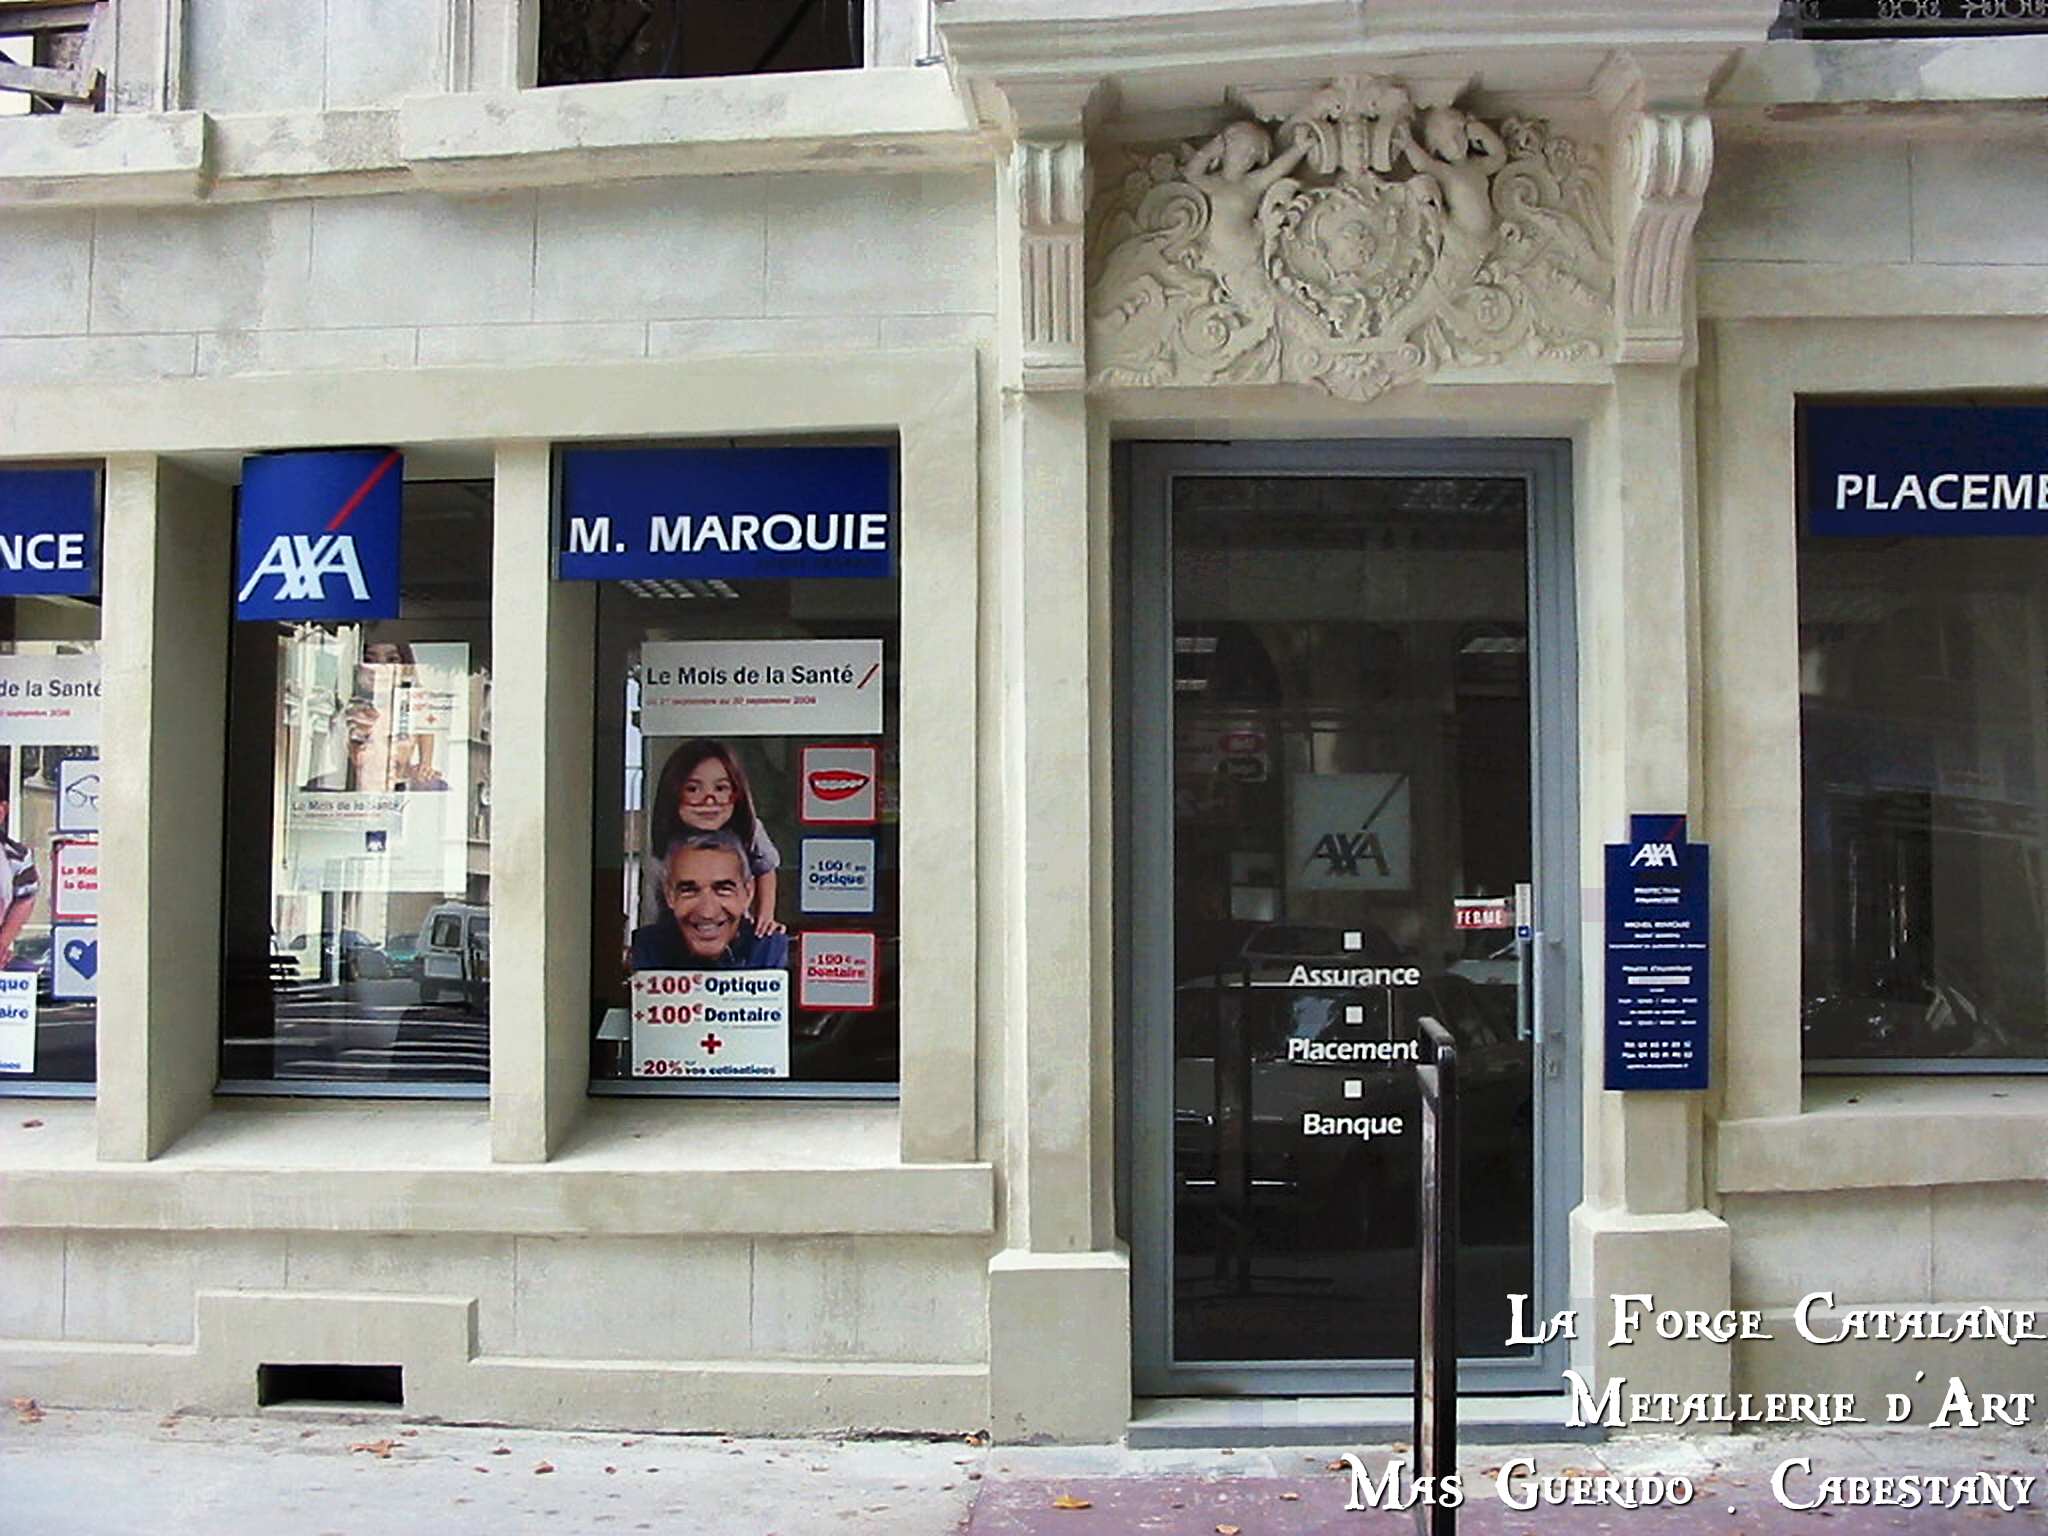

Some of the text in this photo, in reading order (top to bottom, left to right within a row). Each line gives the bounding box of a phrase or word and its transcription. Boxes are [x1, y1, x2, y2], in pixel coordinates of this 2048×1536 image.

[569, 513, 888, 553] M. MARQUIE
[238, 534, 370, 602] AXA
[646, 664, 854, 685] Le Mois de la Santé
[26, 680, 42, 697] la
[1302, 832, 1392, 877] AXA
[1629, 842, 1679, 868] AXA
[808, 872, 866, 887] Optique
[704, 976, 782, 996] Optique
[1289, 964, 1421, 986] Assurance
[704, 1007, 782, 1022] Dentaire
[1287, 1037, 1420, 1061] Placement
[1303, 1113, 1404, 1142] Banque
